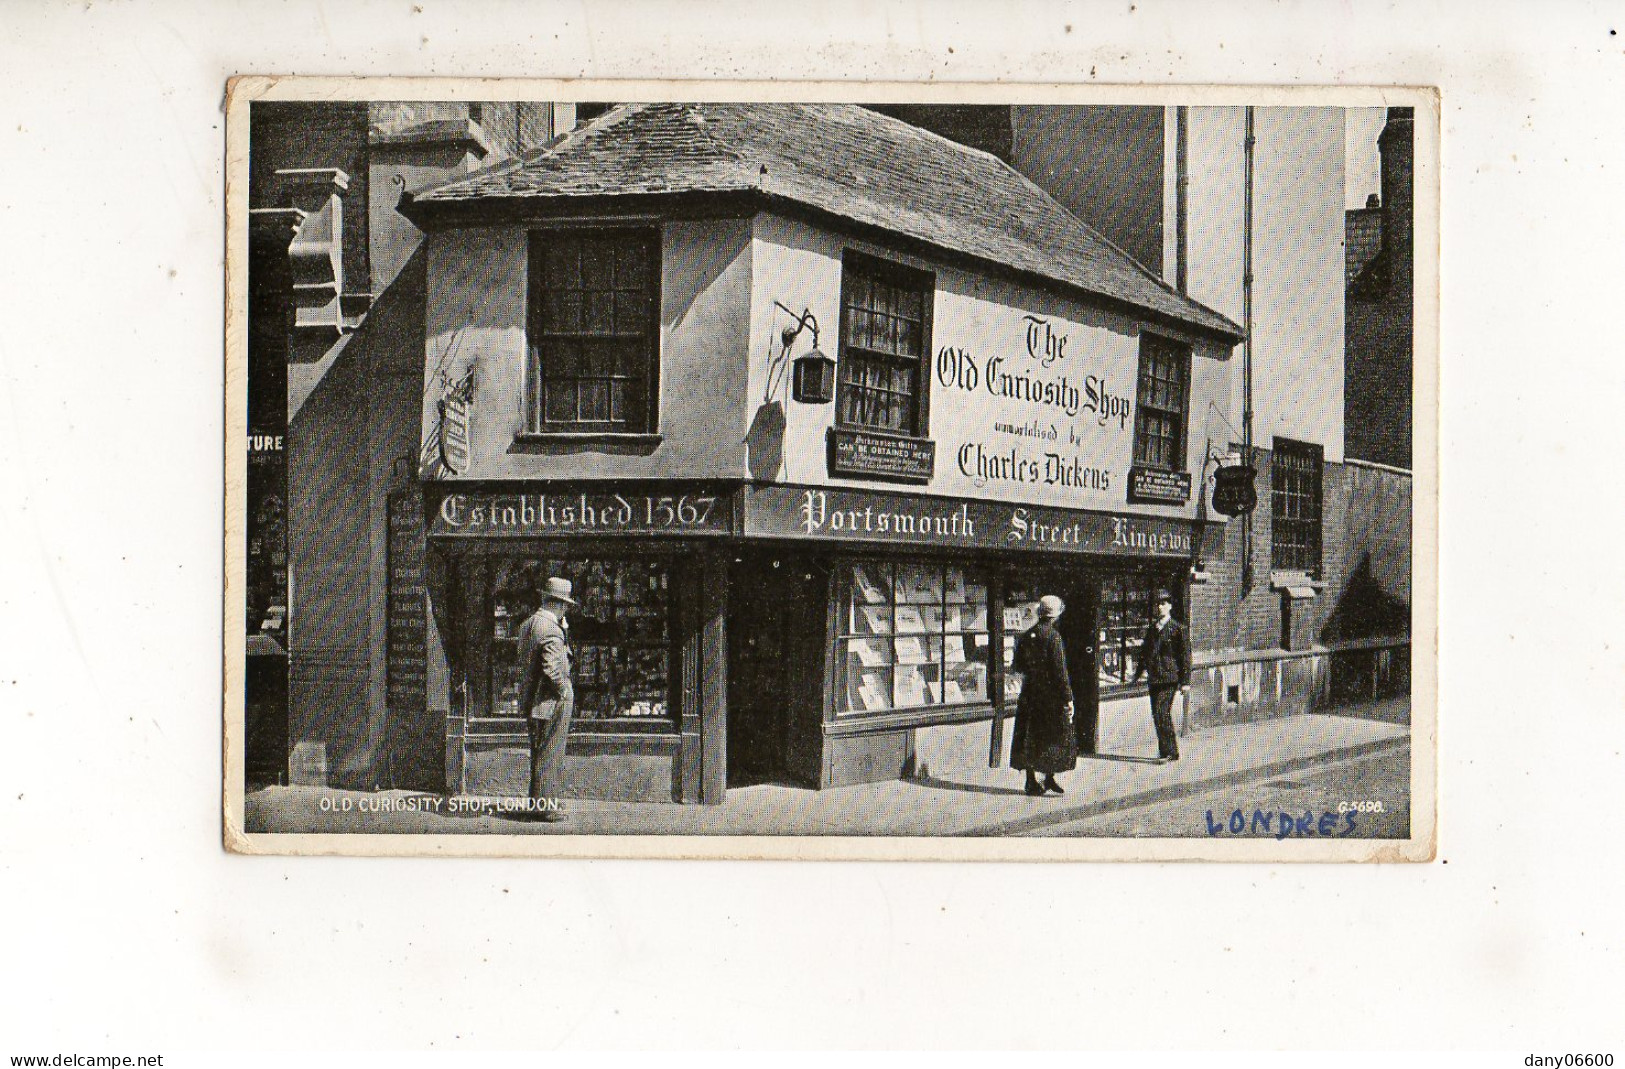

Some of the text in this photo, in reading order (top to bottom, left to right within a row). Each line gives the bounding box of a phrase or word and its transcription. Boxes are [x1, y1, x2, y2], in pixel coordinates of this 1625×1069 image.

[1022, 314, 1069, 368] The
[936, 344, 1130, 429] Old Curiosity Shop
[838, 442, 854, 451] CAN
[858, 445, 868, 454] BE
[871, 446, 909, 458] OBTAINED
[957, 442, 1110, 491] Charles Dickens
[440, 493, 632, 527] Established
[645, 495, 716, 527] 1567
[799, 489, 975, 537] Portsmouth
[1111, 516, 1192, 550] Kingswa
[1205, 808, 1358, 840] LONDRES
